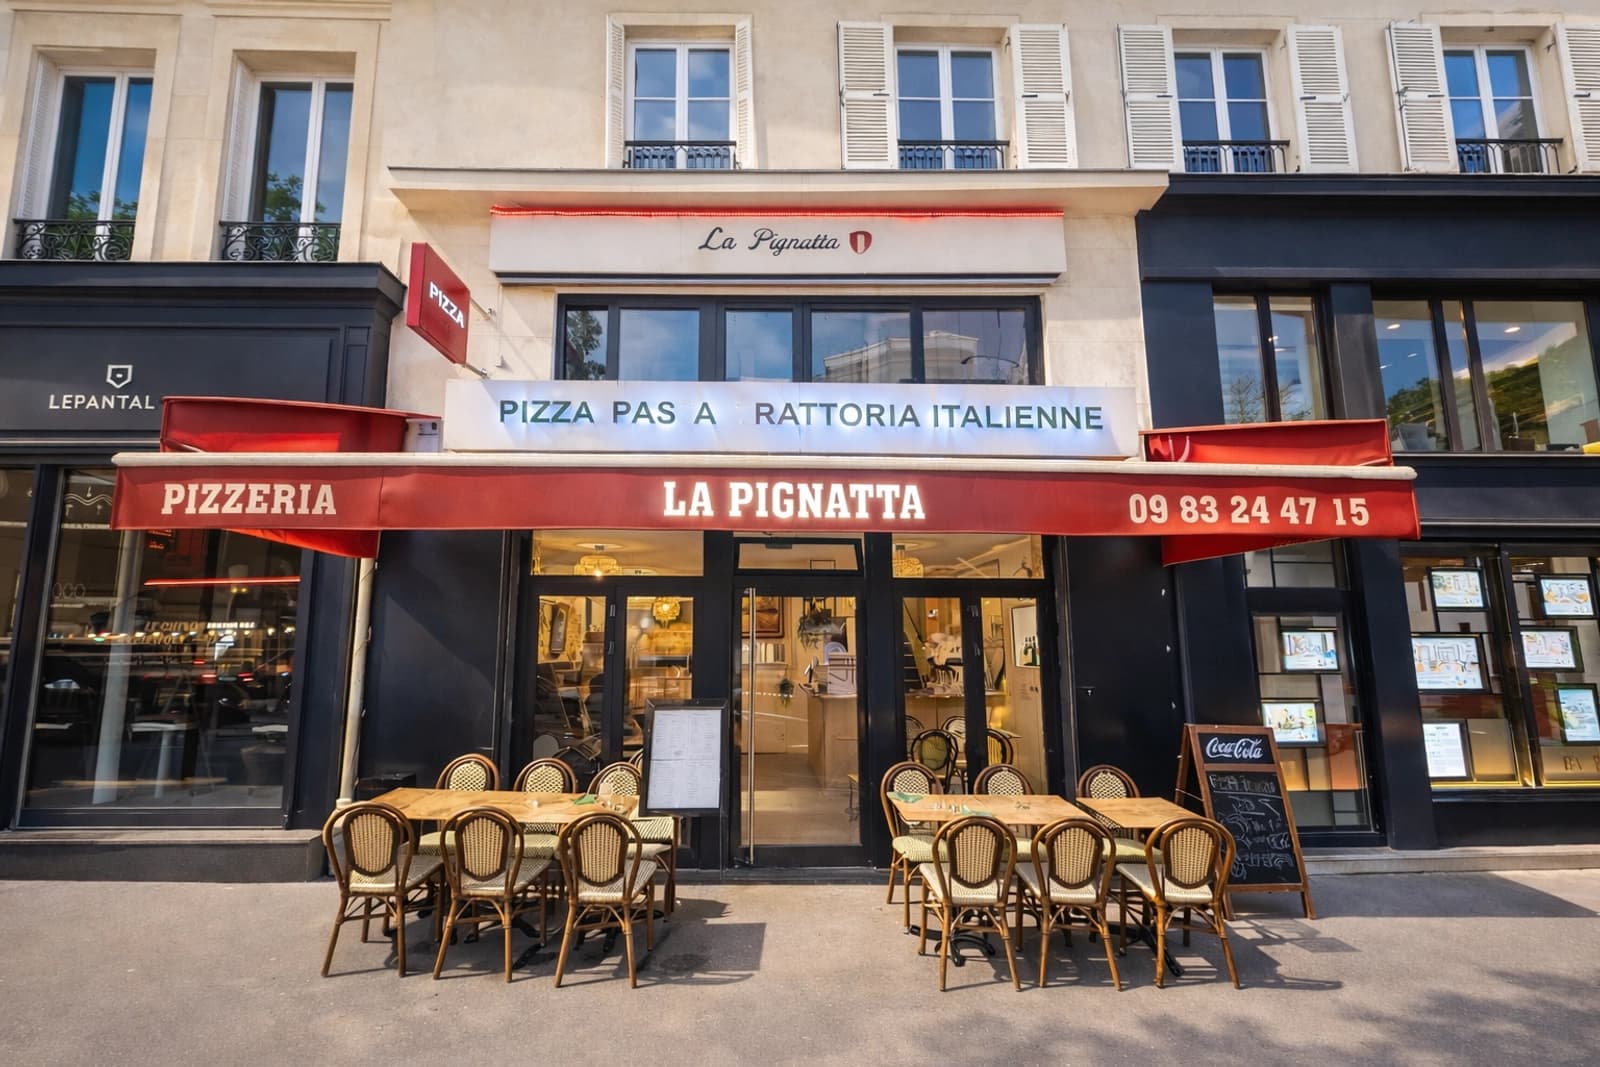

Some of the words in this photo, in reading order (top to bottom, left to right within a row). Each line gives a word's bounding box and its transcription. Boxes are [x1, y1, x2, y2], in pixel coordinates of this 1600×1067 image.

[698, 226, 737, 251] La
[747, 227, 841, 257] Pignatta
[429, 281, 465, 329] PIZZA
[48, 394, 155, 411] LEPANTAL
[499, 400, 595, 424] PIZZA
[612, 401, 676, 424] PAS
[694, 402, 717, 425] A
[933, 404, 1104, 430] ITALIENNE
[160, 483, 337, 515] PIZZERIA
[663, 481, 714, 517] LA
[728, 482, 926, 520] PIGNATTA
[1129, 493, 1168, 524] 09
[1179, 495, 1219, 524] 83
[1230, 495, 1270, 524] 24
[1280, 496, 1317, 525] 47
[1333, 497, 1370, 526] 15
